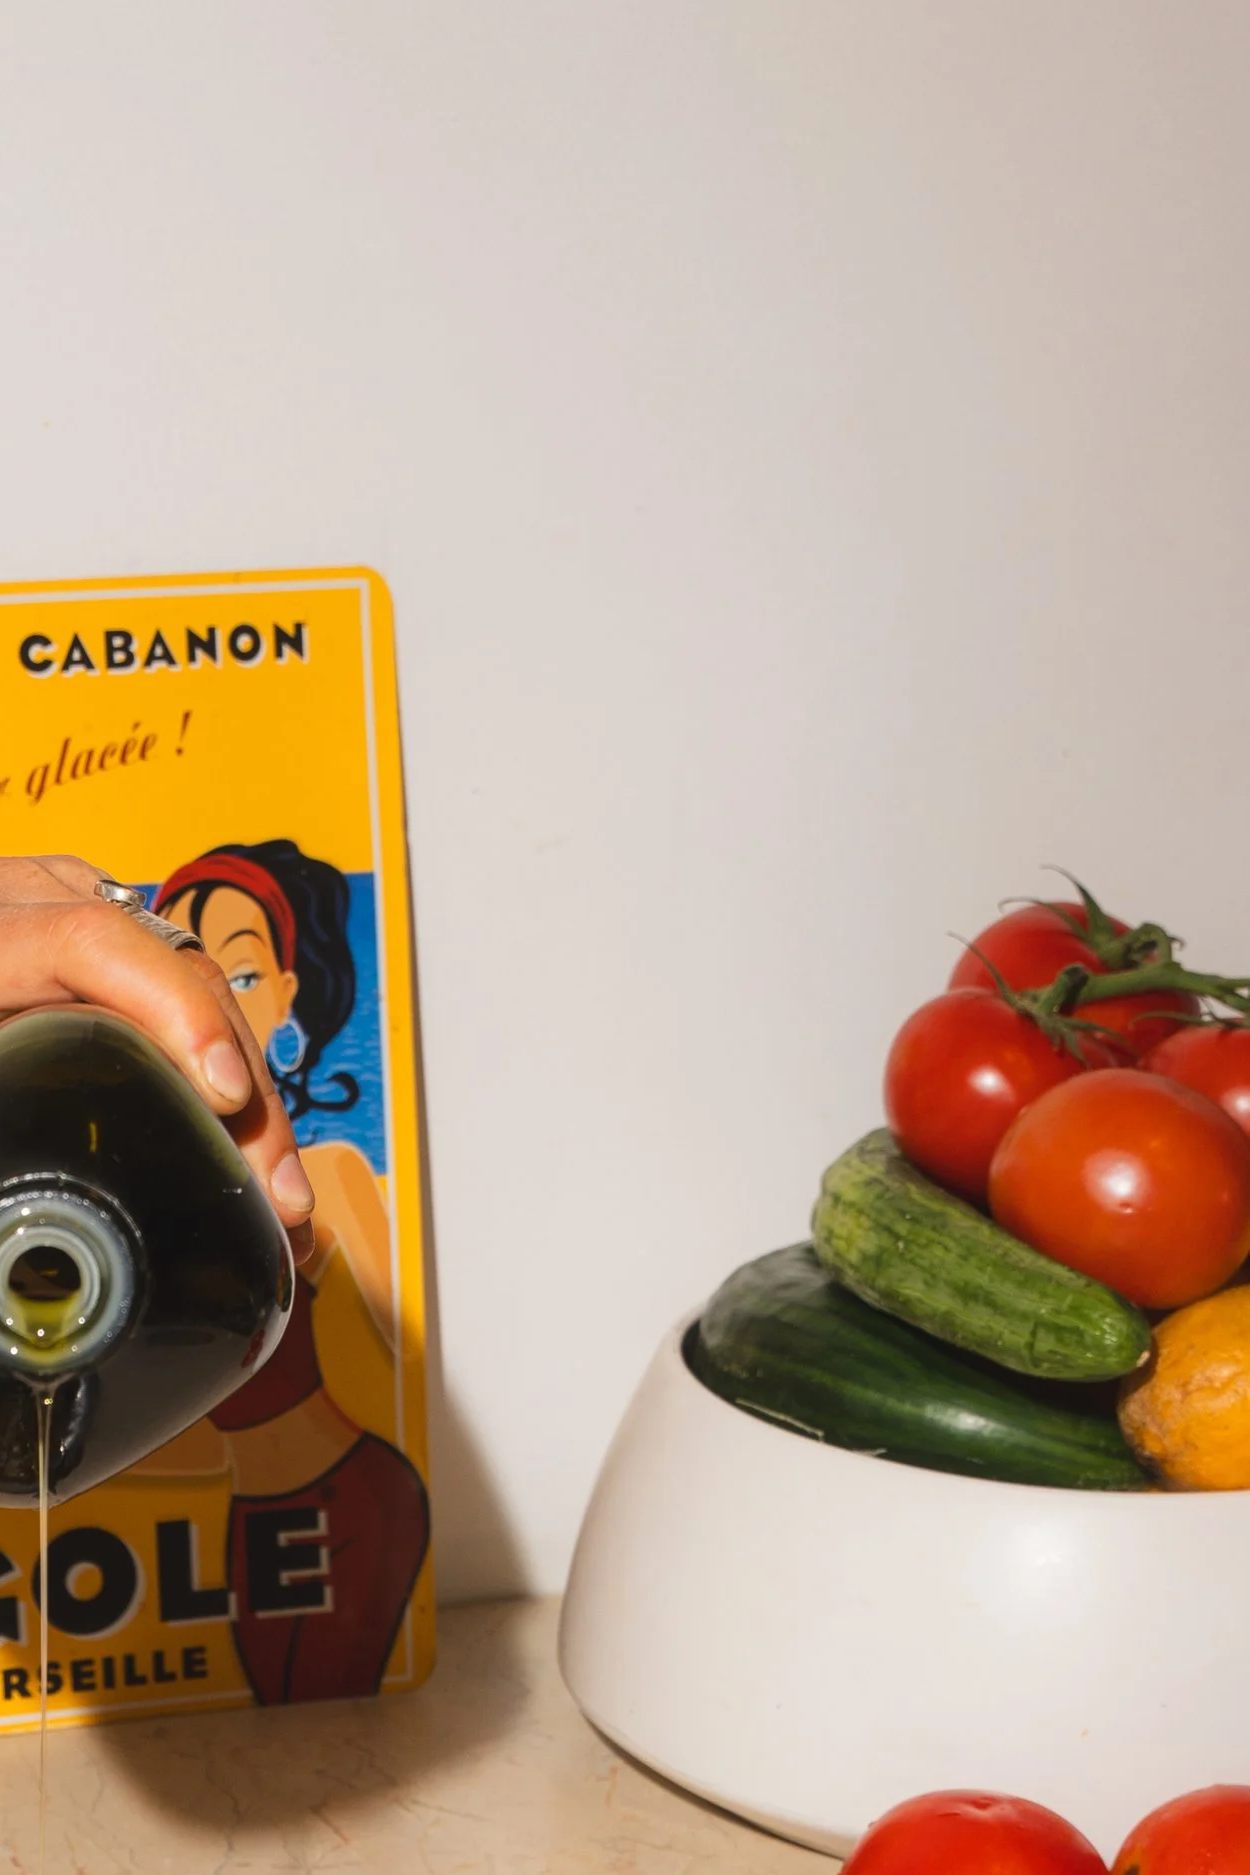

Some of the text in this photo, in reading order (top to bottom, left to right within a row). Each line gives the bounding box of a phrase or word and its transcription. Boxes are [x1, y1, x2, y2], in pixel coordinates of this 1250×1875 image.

[19, 621, 310, 676] CABANON
[24, 720, 158, 806] glacée
[175, 709, 193, 757] !
